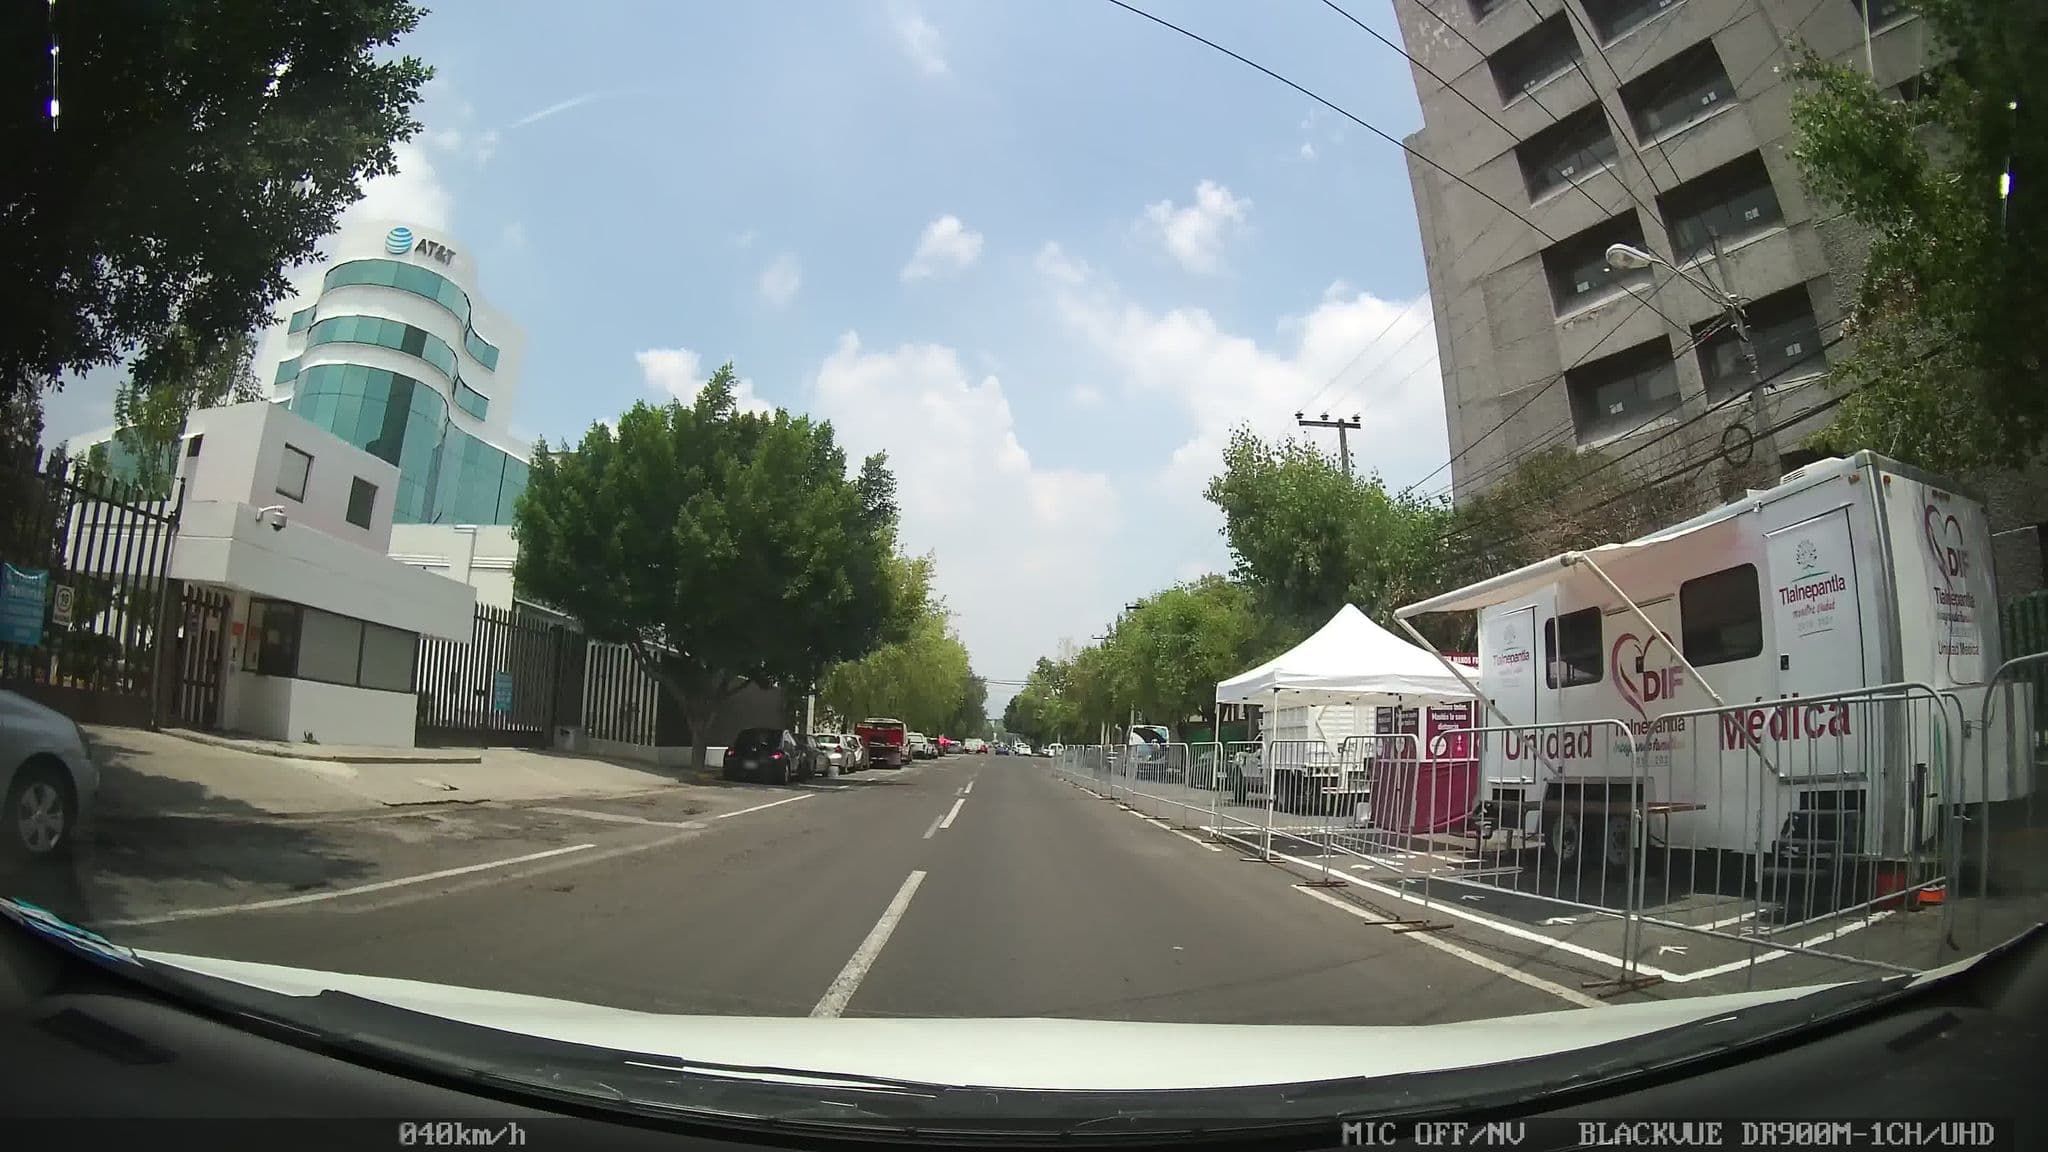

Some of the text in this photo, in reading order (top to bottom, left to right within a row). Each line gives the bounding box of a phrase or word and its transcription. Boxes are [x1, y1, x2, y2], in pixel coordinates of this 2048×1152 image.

[414, 238, 457, 265] AT&T
[1947, 547, 1969, 578] DIF
[1778, 574, 1846, 606] Tlalnepantla
[1643, 666, 1684, 703] DIF
[1506, 692, 1852, 760] Unidad Médica
